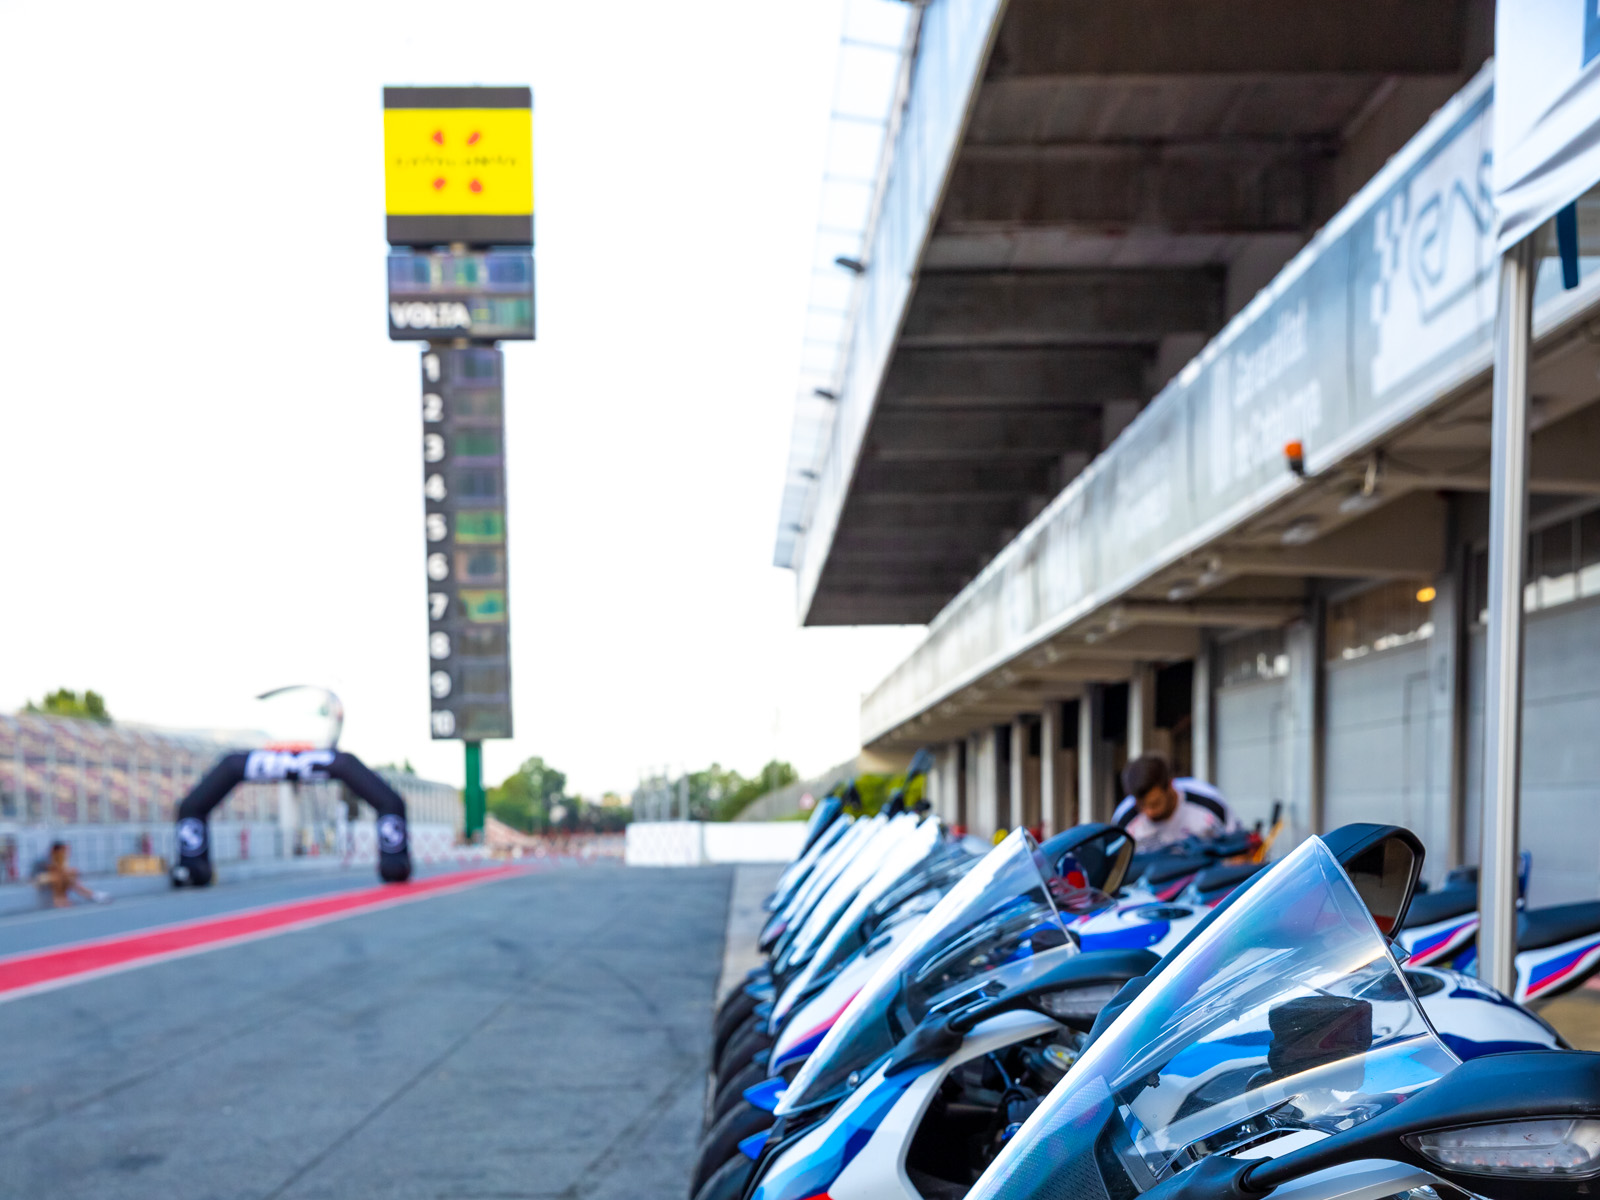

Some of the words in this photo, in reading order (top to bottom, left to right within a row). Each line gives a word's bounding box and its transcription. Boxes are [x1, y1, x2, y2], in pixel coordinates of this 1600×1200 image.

[390, 301, 472, 329] VOLTA
[423, 353, 440, 382] 1
[423, 393, 443, 422] 2
[424, 433, 445, 463] 3
[425, 473, 447, 502] 4
[427, 513, 447, 542] 5
[428, 552, 449, 581] 6
[428, 592, 449, 620] 7
[429, 631, 451, 660] 8
[430, 670, 451, 699] 9
